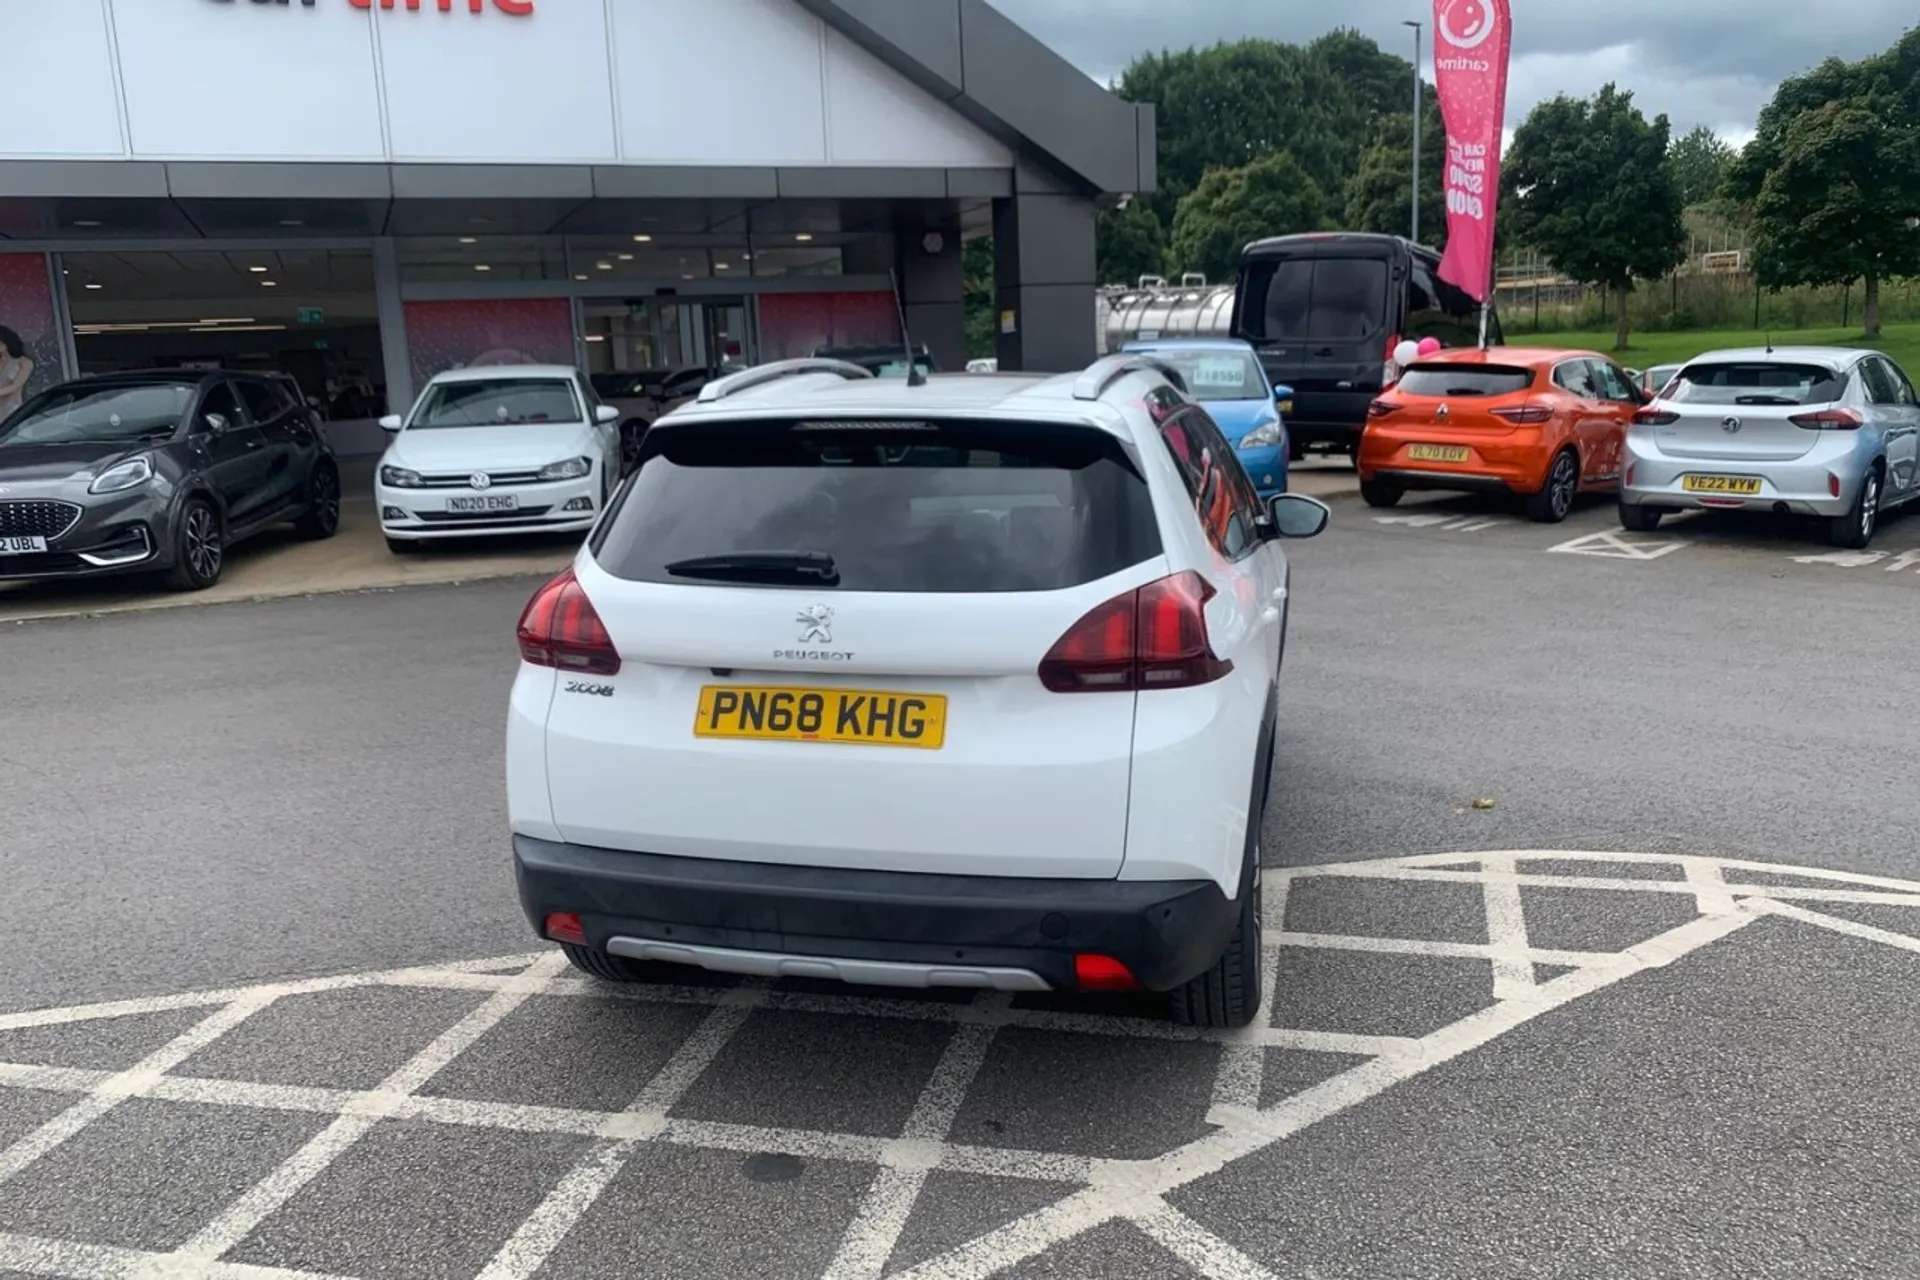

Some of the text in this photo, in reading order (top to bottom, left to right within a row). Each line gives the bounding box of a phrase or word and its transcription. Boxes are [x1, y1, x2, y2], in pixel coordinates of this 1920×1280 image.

[1690, 477, 1757, 492] VE22 WYW
[451, 496, 513, 510] ND20 EHG
[10, 537, 42, 551] UBL
[773, 650, 856, 661] PEUGEOT
[564, 681, 615, 697] 2008
[710, 691, 927, 739] PN68 KHG
